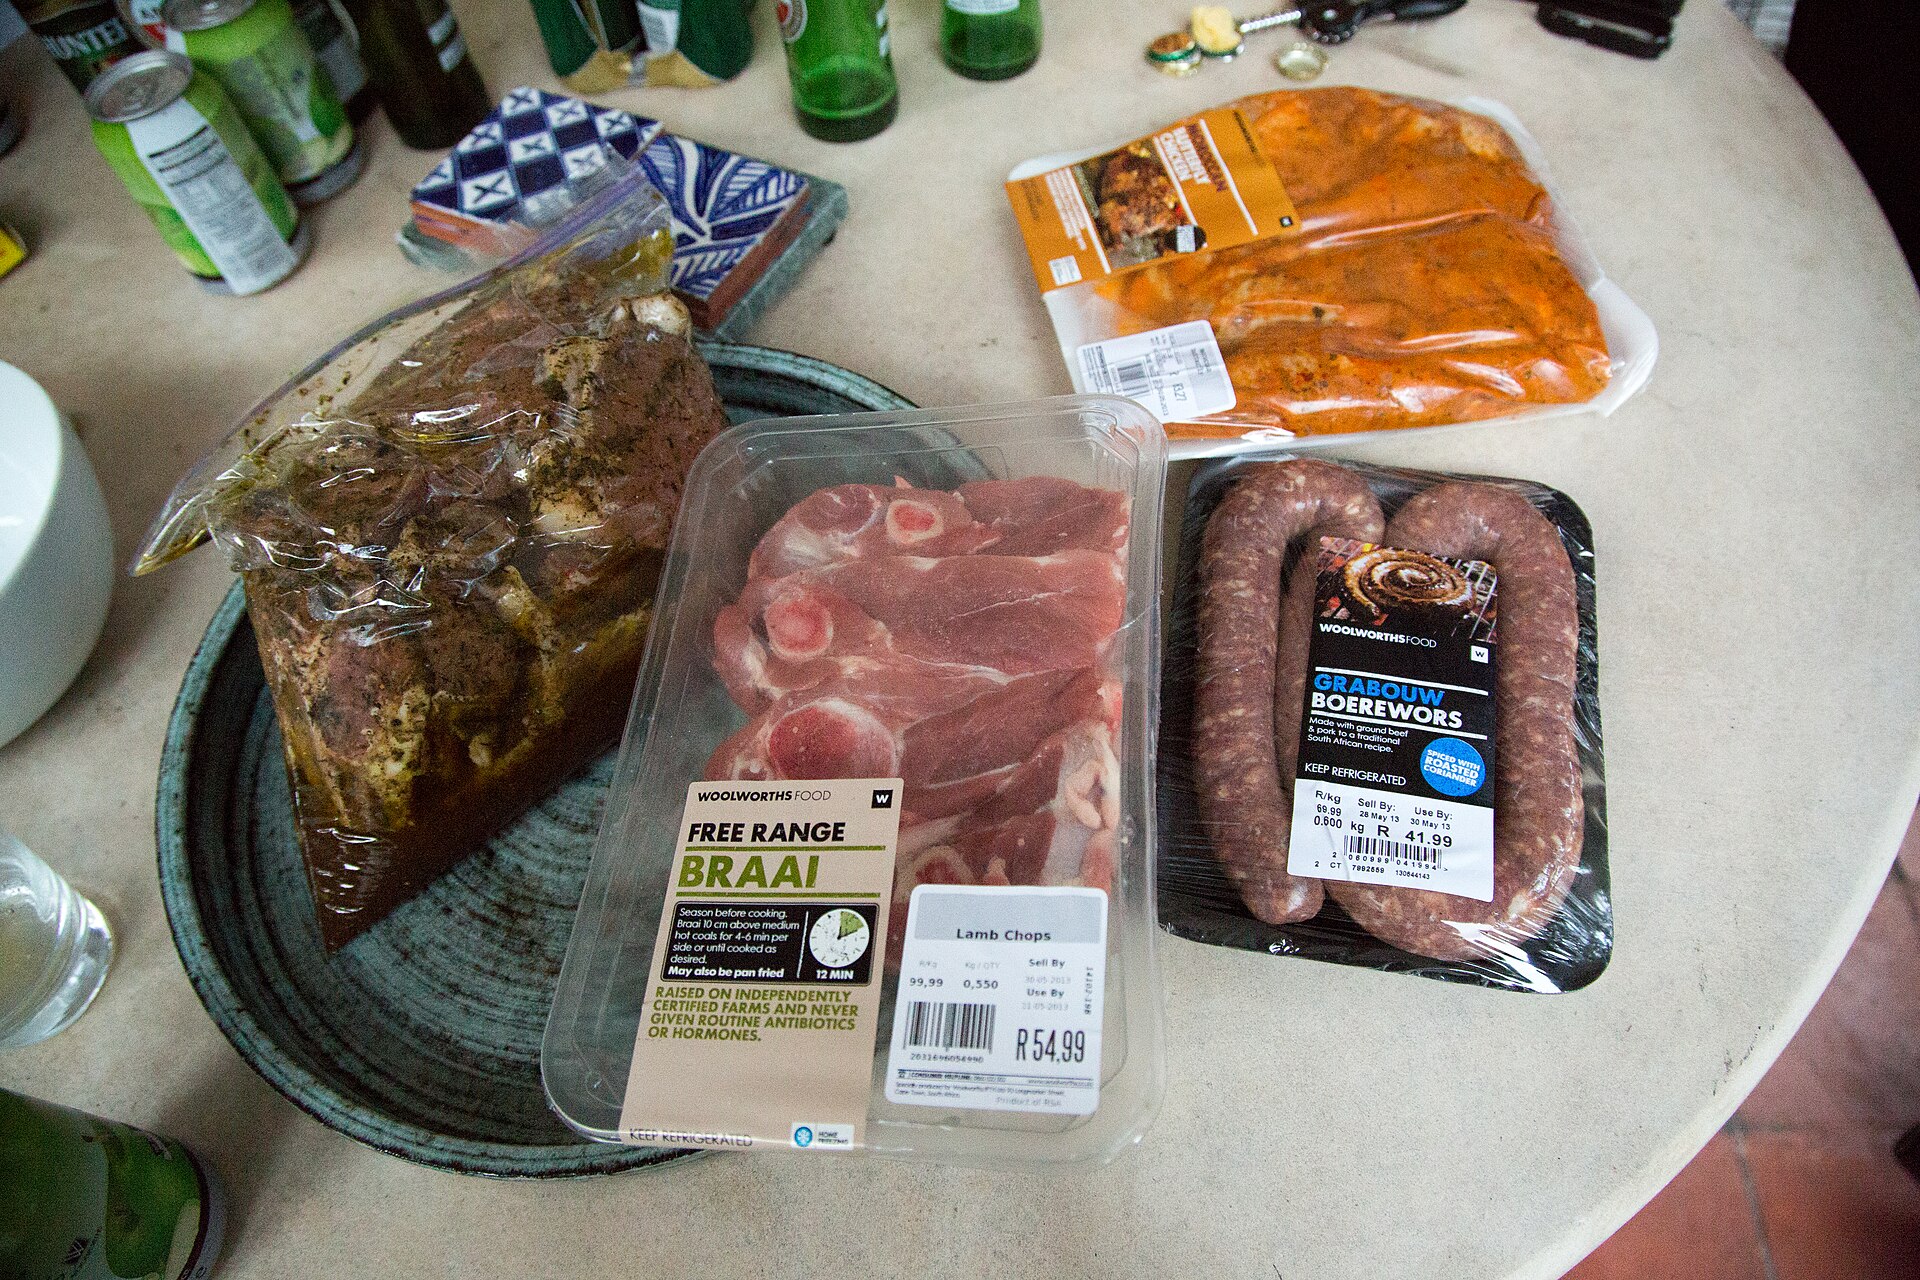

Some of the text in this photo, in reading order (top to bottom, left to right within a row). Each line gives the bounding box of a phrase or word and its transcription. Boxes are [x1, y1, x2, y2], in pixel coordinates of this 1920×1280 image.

[1313, 673, 1446, 707] GRABOUW
[1311, 691, 1463, 729] BOEREWORS
[1309, 717, 1409, 738] Made with ground beef
[1308, 725, 1315, 733] &
[1316, 727, 1337, 736] pork
[1357, 732, 1400, 746] traditional
[1307, 734, 1394, 753] South African recipe.
[1424, 755, 1479, 779] ROASTED
[1427, 749, 1481, 771] SPICED WITH
[1304, 762, 1407, 786] KEEP REFRIGERATED
[1423, 764, 1477, 787] CORIANDER
[698, 790, 832, 802] WOOLWORTHS FOOD
[1315, 790, 1341, 805] R/kg
[1316, 804, 1342, 817] 69.99
[1358, 798, 1396, 812] Sell By:
[1359, 810, 1400, 823] 28 May 13
[1414, 806, 1453, 821] Use By:
[1314, 815, 1365, 834] 0.600 kg
[1410, 818, 1451, 831] 30 May 13
[687, 822, 846, 843] FREE RANGE
[1377, 824, 1453, 848] R 41.99
[678, 855, 820, 889] BRAAI
[1330, 861, 1342, 869] CT
[679, 907, 788, 920] Season before cooking.
[677, 920, 701, 929] Braai
[703, 920, 712, 929] 10
[730, 920, 761, 930] above
[762, 921, 800, 930] medium
[674, 931, 789, 944] hot coals for 4-6 min per
[956, 928, 1051, 943] Lamb Chops
[672, 943, 692, 952] side
[706, 943, 725, 953] until
[726, 944, 763, 953] cooked
[670, 954, 707, 964] desired.
[1028, 958, 1066, 969] Sell By
[668, 966, 785, 979] May also be pan fried
[816, 969, 854, 980] 12 MIN
[909, 977, 943, 988] 99,99
[963, 979, 999, 990] 0,550
[655, 986, 852, 1003] RAISED ON INDEPENDENTLY
[1027, 988, 1065, 999] Use By
[653, 1000, 859, 1017] CERTIFIED FARMS AND NEVER
[650, 1013, 856, 1031] GIVEN ROUTINE ANTIBIOTICS
[648, 1026, 762, 1042] OR HORMONES.
[1016, 1028, 1085, 1064] R 54.99
[629, 1128, 753, 1147] KEEP REFRIGERATED
